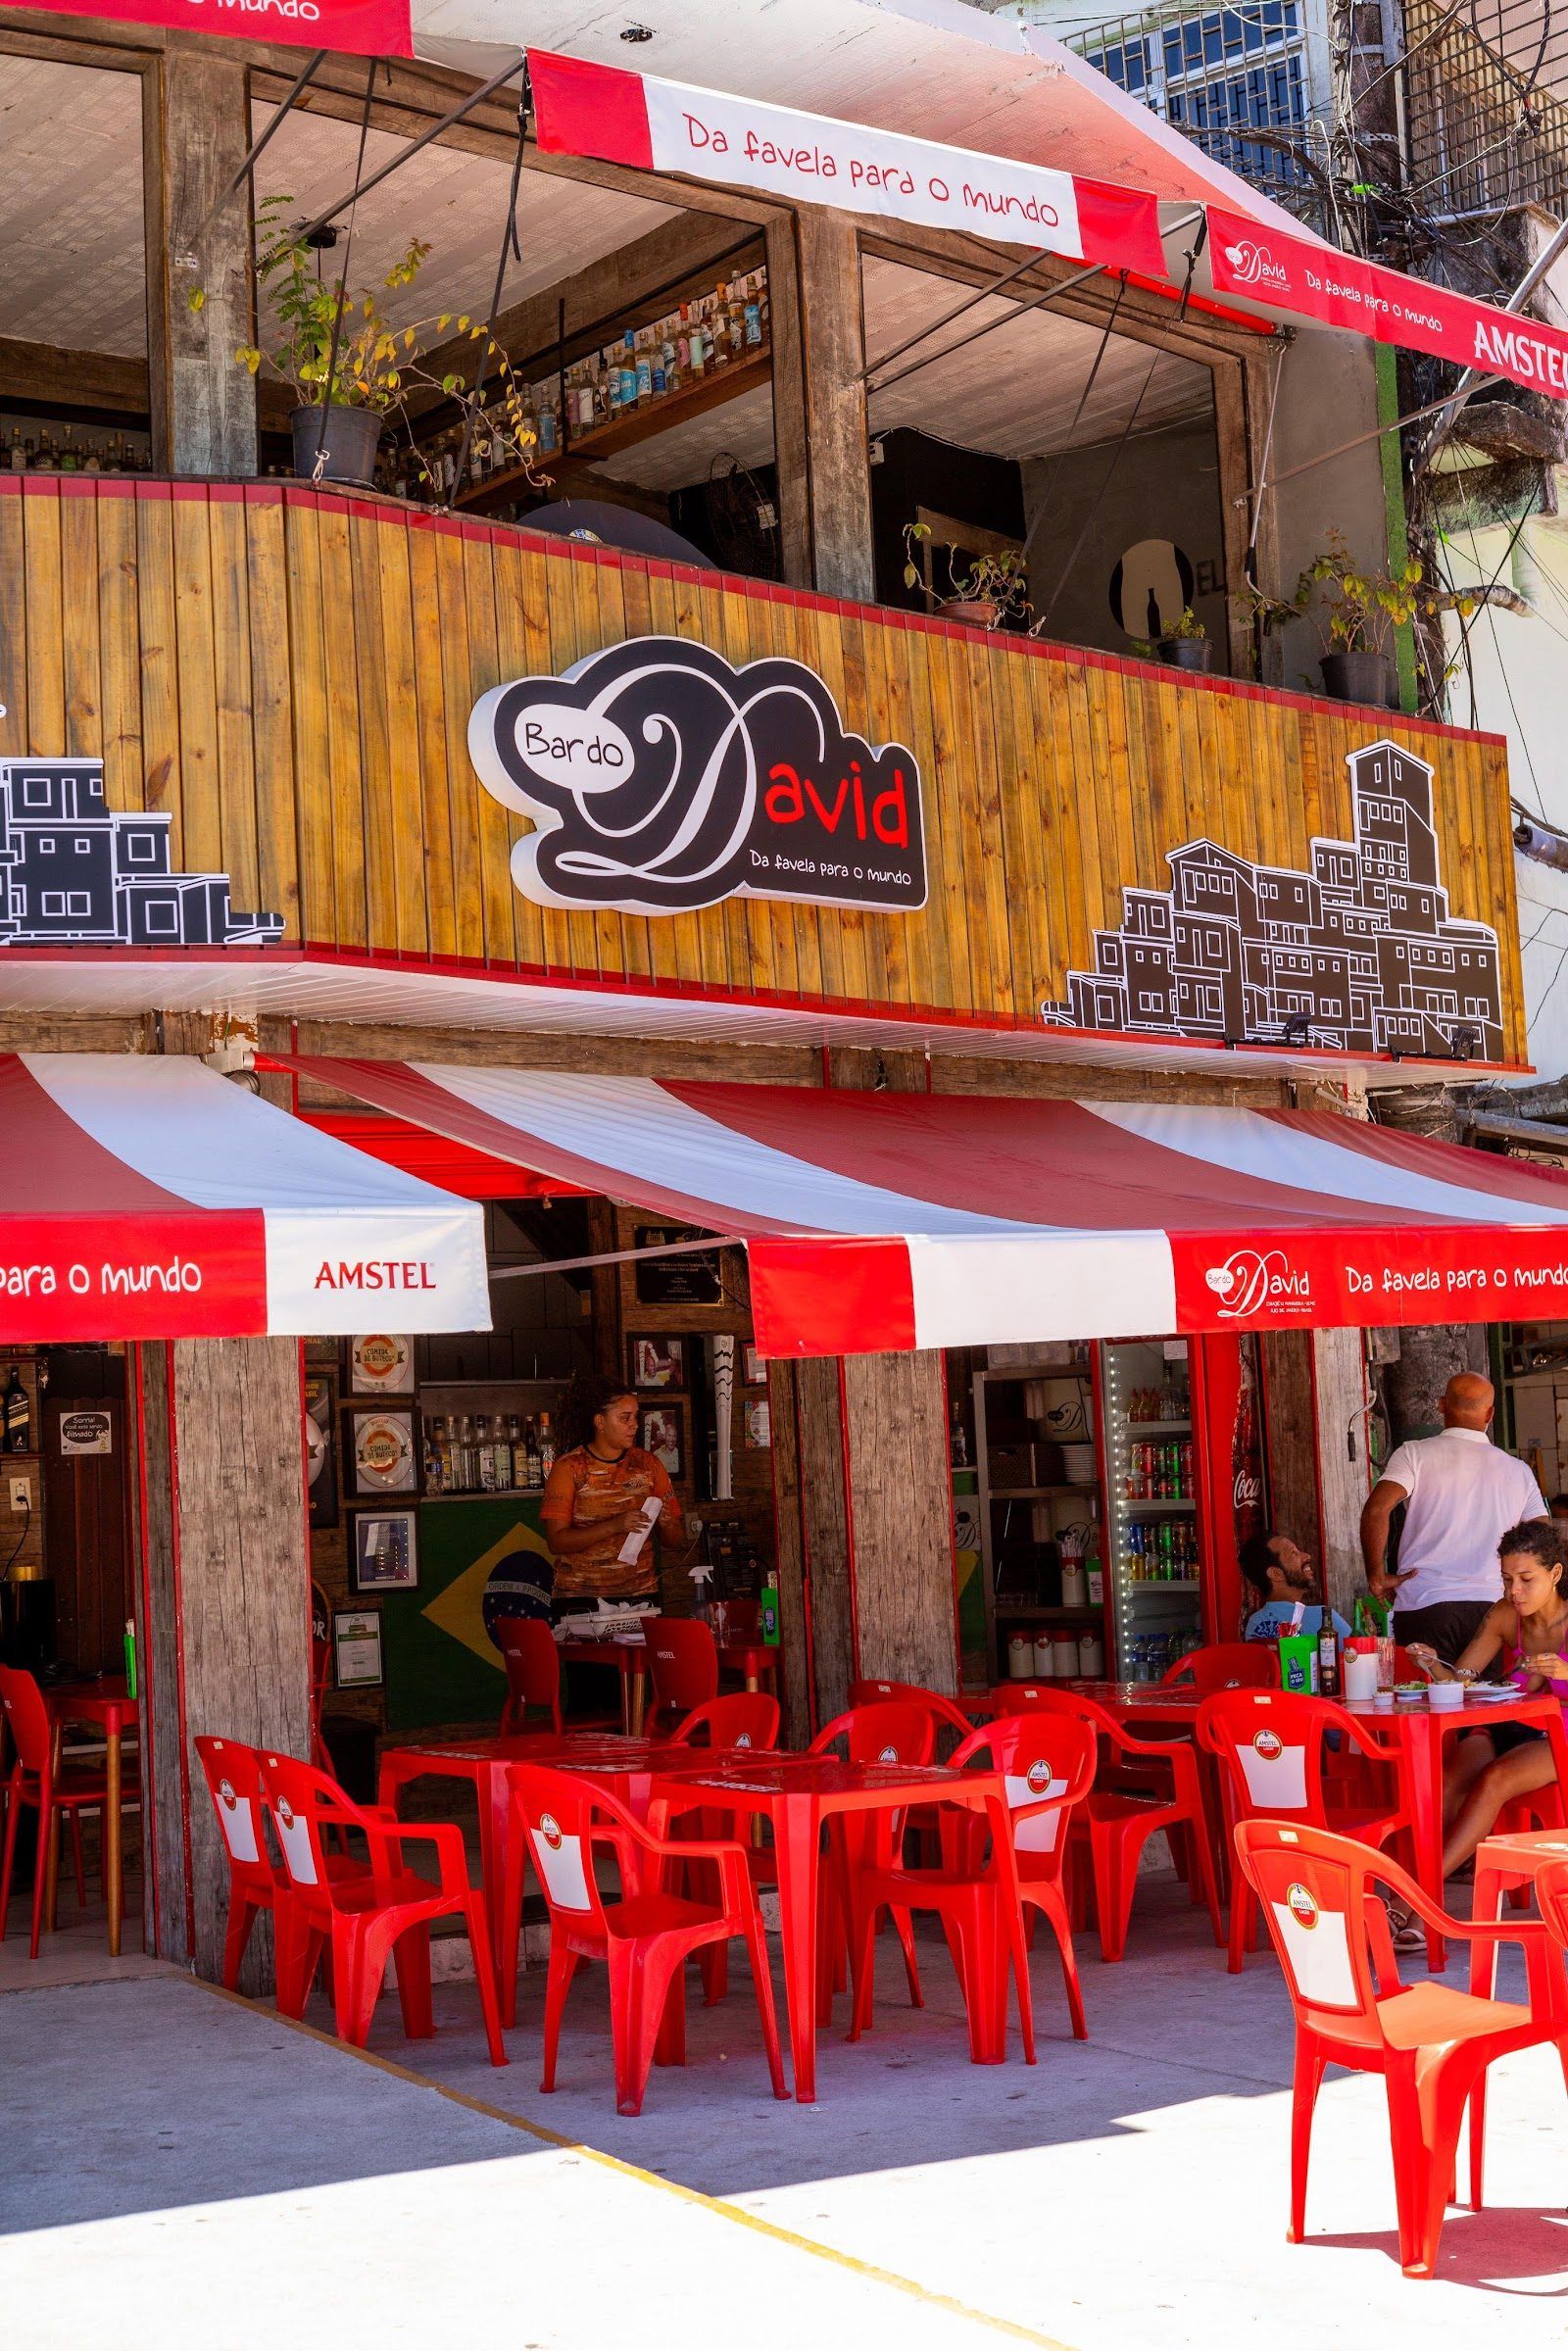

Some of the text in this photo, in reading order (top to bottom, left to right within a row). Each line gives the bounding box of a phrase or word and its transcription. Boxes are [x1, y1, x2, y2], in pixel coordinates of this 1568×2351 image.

[683, 113, 728, 152] Da
[744, 129, 836, 176] favela
[850, 160, 914, 194] para
[963, 183, 1058, 226] mundo
[1304, 269, 1322, 291] Da
[1326, 278, 1361, 303] favela
[1364, 294, 1390, 313] para
[1405, 308, 1443, 332] mundo
[555, 663, 907, 883] David
[750, 849, 769, 867] Da
[774, 855, 815, 873] favela
[819, 862, 849, 877] para
[867, 868, 911, 885] mundo
[101, 1255, 202, 1296] mundo
[314, 1261, 437, 1290] AMSTEL
[1217, 1249, 1310, 1317] David
[1345, 1266, 1373, 1293] Da
[1382, 1266, 1441, 1293] favela
[1446, 1268, 1487, 1293] para
[1293, 1899, 1312, 1909] AMSTEL
